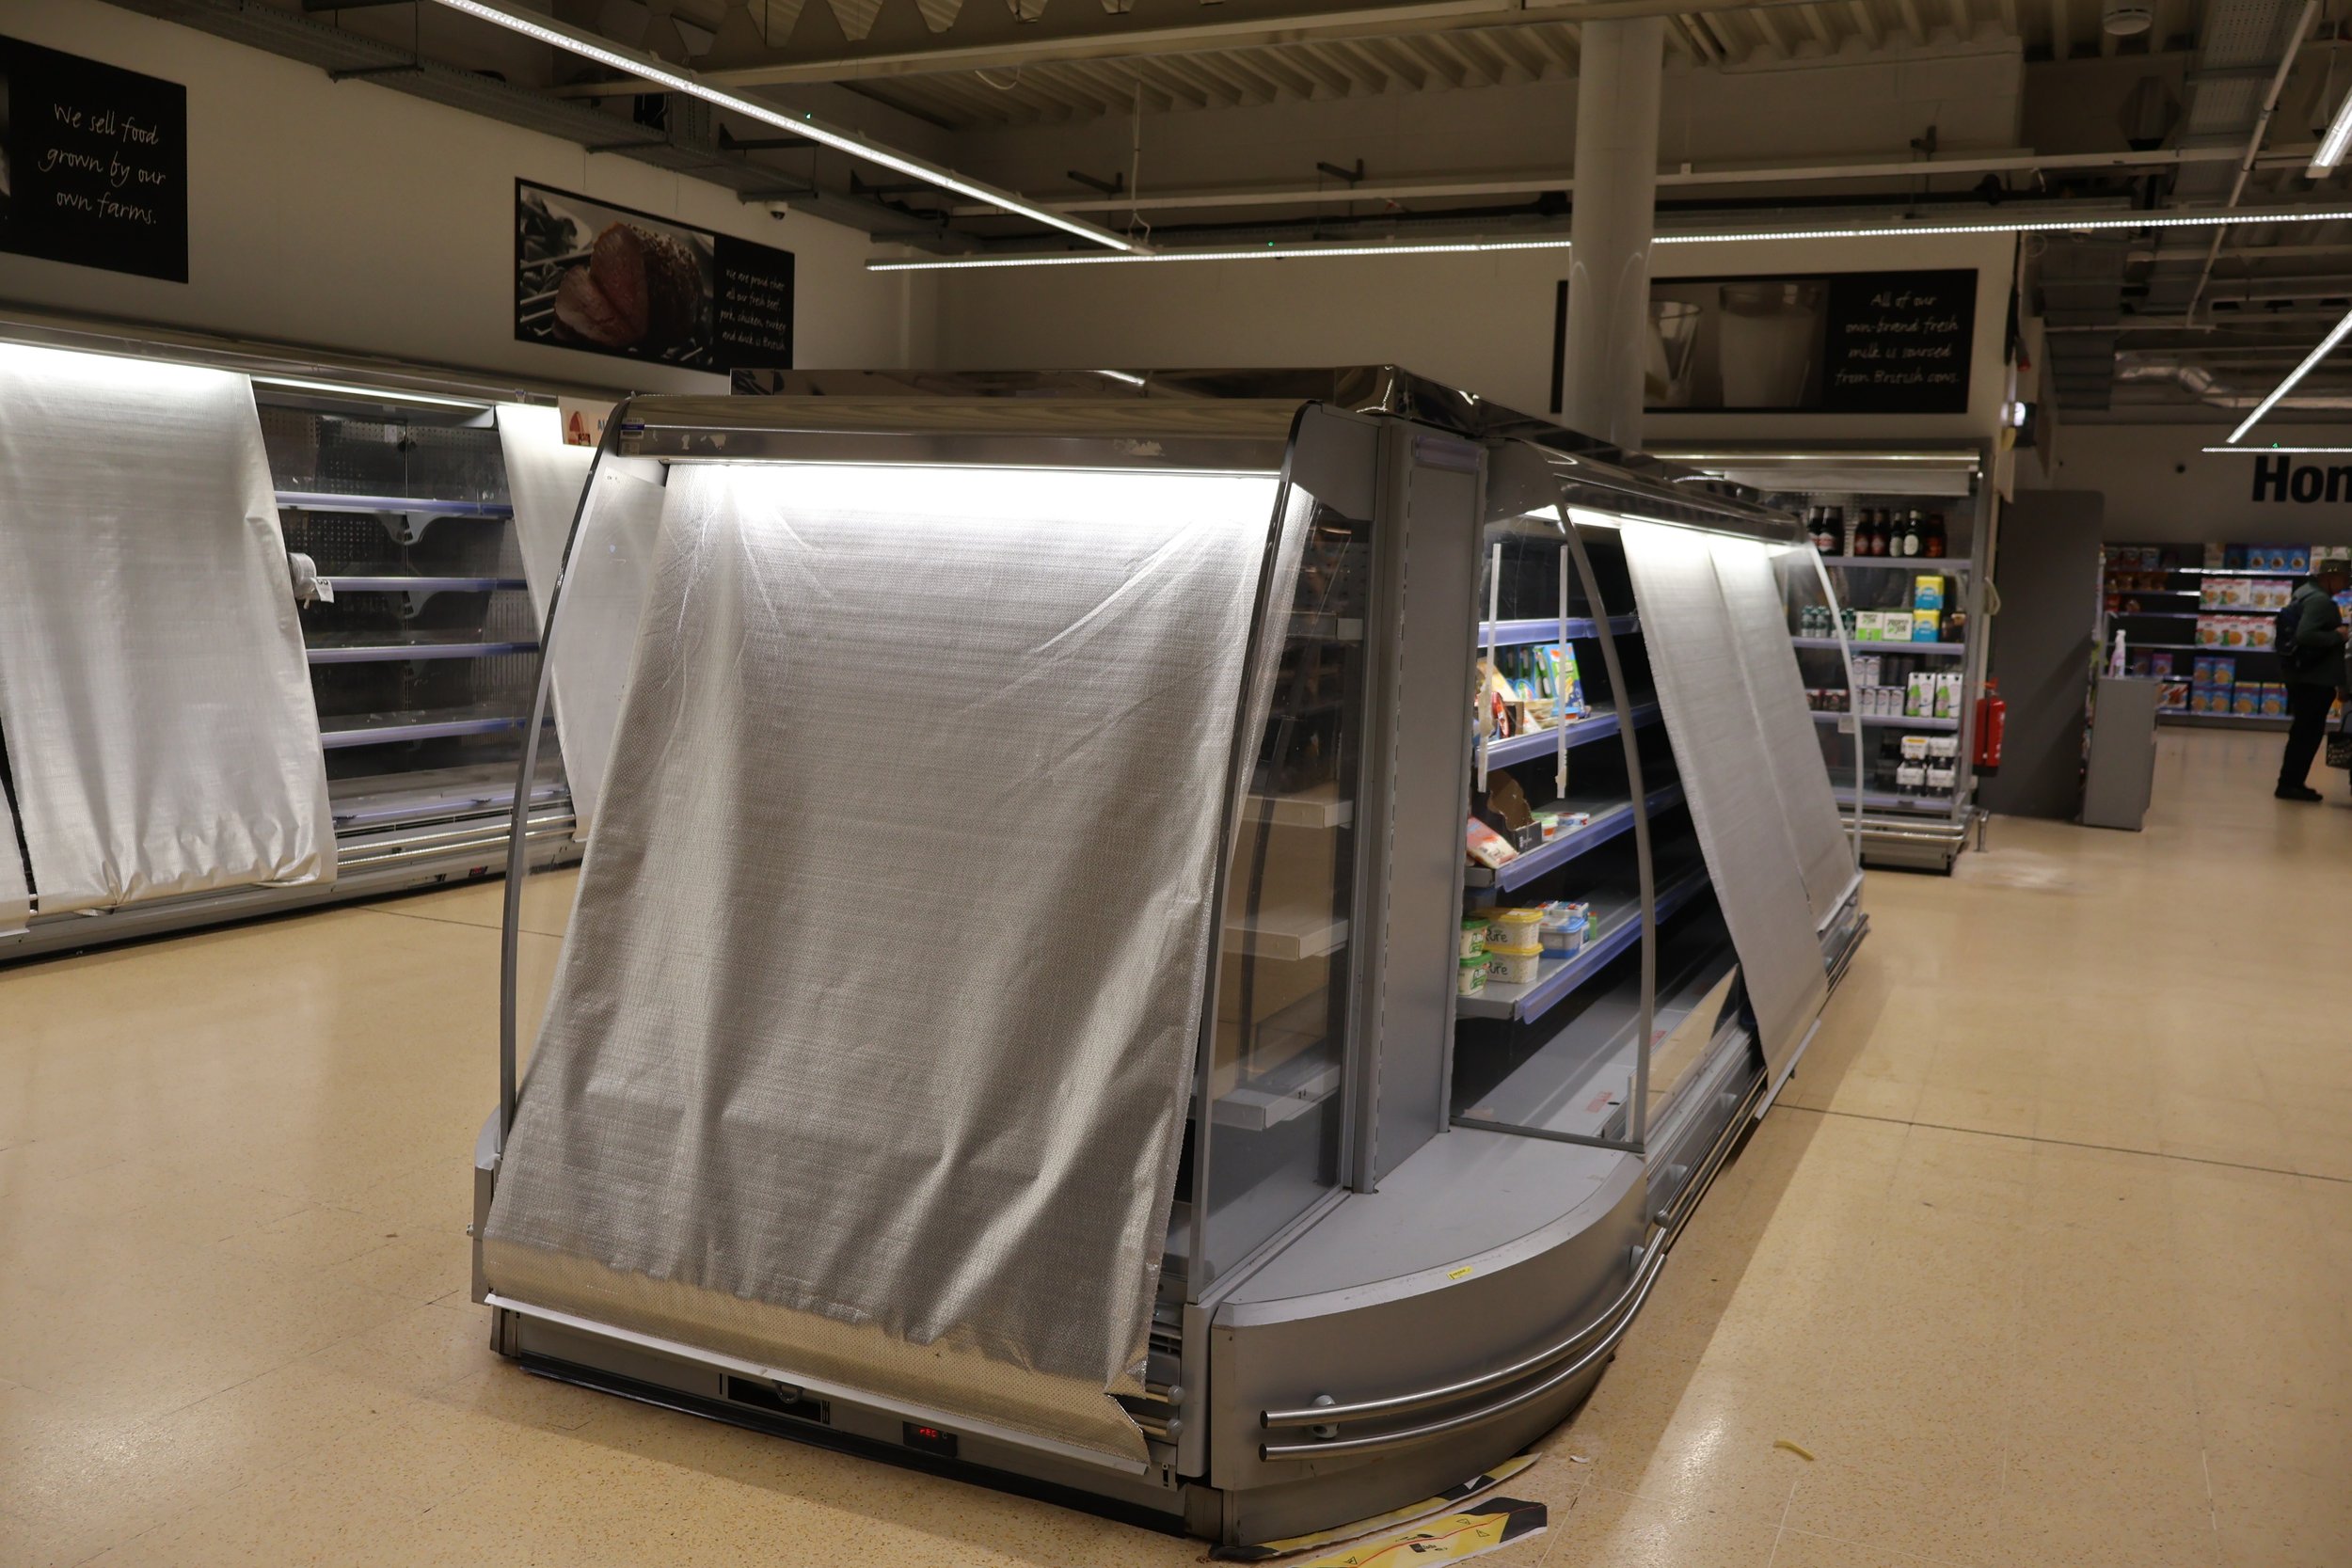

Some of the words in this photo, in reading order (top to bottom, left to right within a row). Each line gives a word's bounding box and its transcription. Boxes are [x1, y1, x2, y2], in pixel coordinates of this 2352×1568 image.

[54, 103, 81, 129] We
[88, 110, 116, 135] sell
[121, 117, 158, 145] food
[38, 148, 103, 173] grown
[110, 151, 130, 187] by
[138, 169, 167, 185] our
[56, 192, 92, 211] own
[97, 192, 157, 225] farms.
[1870, 290, 1892, 308] All
[1895, 290, 1912, 309] of
[1923, 312, 1959, 335] fresh
[1835, 368, 1870, 387] from
